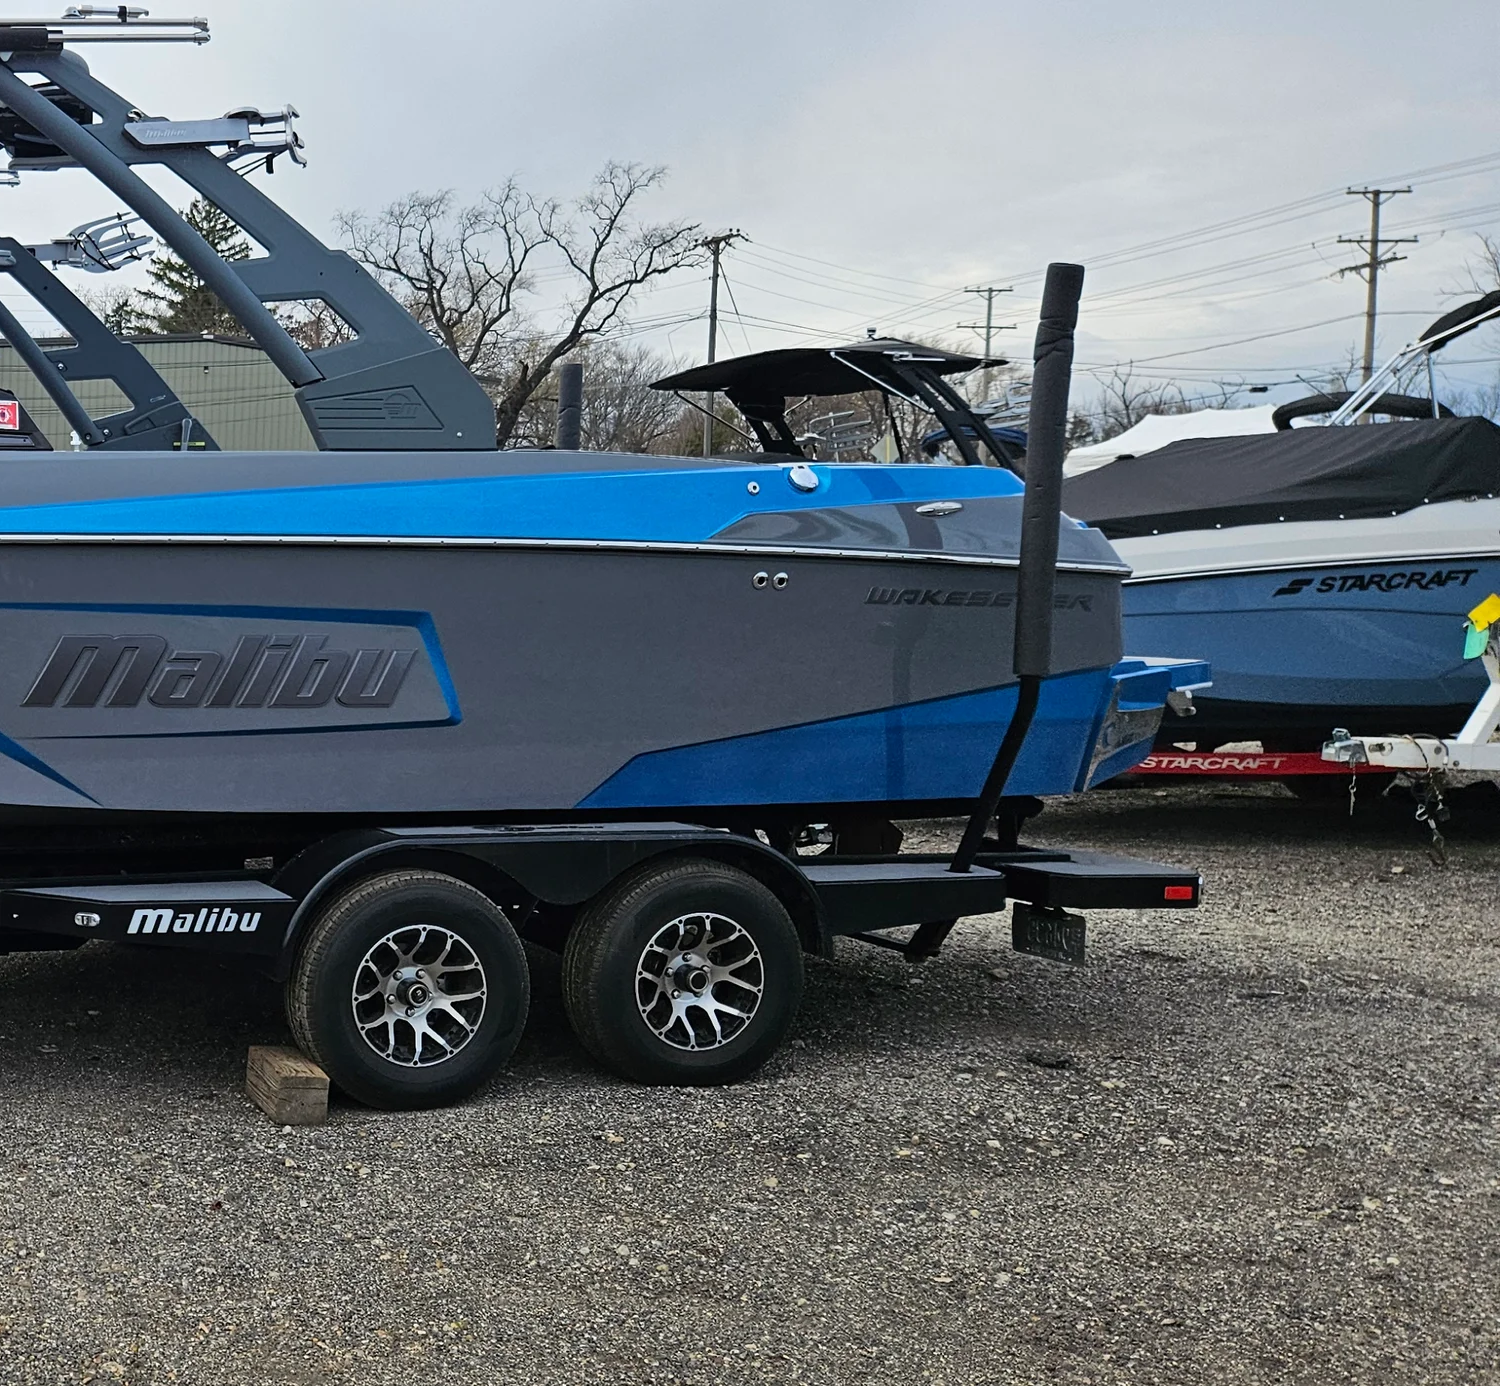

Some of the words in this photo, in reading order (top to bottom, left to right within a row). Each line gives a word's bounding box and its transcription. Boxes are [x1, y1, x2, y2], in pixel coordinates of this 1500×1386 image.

[1315, 568, 1479, 593] STARCRAFT
[863, 585, 1096, 613] WAKESEER
[20, 634, 419, 708] Malibu
[1138, 756, 1288, 771] STARCRAFT
[126, 907, 262, 934] Malibu
